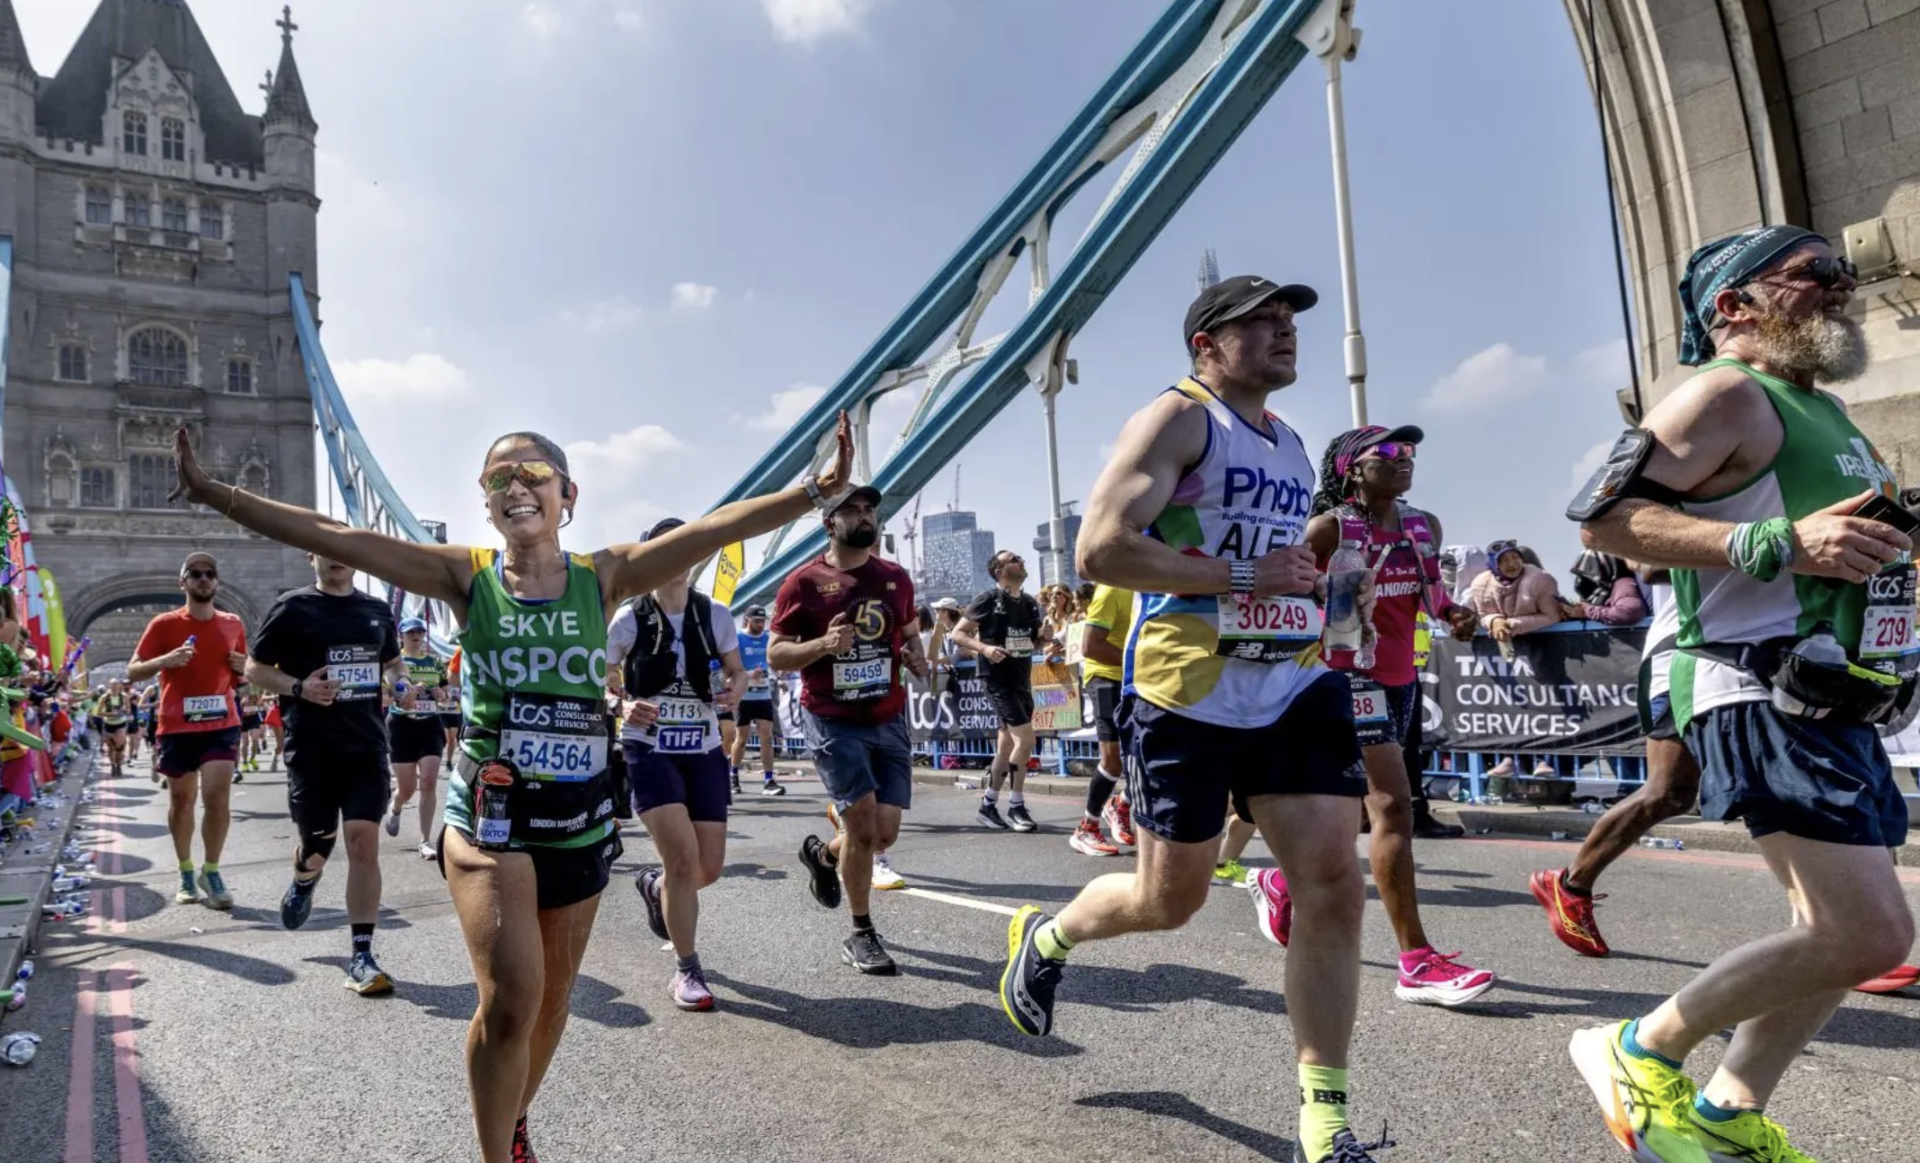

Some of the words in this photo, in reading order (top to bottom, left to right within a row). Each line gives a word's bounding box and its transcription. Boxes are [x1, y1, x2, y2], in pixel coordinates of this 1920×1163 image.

[498, 610, 580, 638] SKYE
[855, 600, 886, 640] 45
[1237, 603, 1307, 630] 30249
[329, 650, 351, 662] tcs
[1455, 655, 1536, 677] TATA
[338, 668, 374, 682] 57541
[844, 663, 882, 683] 59459
[191, 698, 220, 710] 72077
[509, 697, 551, 726] tcs
[556, 701, 581, 710] TATA
[908, 682, 953, 730] tcs
[554, 719, 589, 730] SERVICES
[555, 710, 602, 721] CONSULTANCY
[1457, 712, 1581, 736] SERVICES
[661, 730, 701, 747] TIFF
[518, 740, 592, 771] 54564
[530, 817, 556, 828] LONDON
[557, 810, 588, 828] MARATHON
